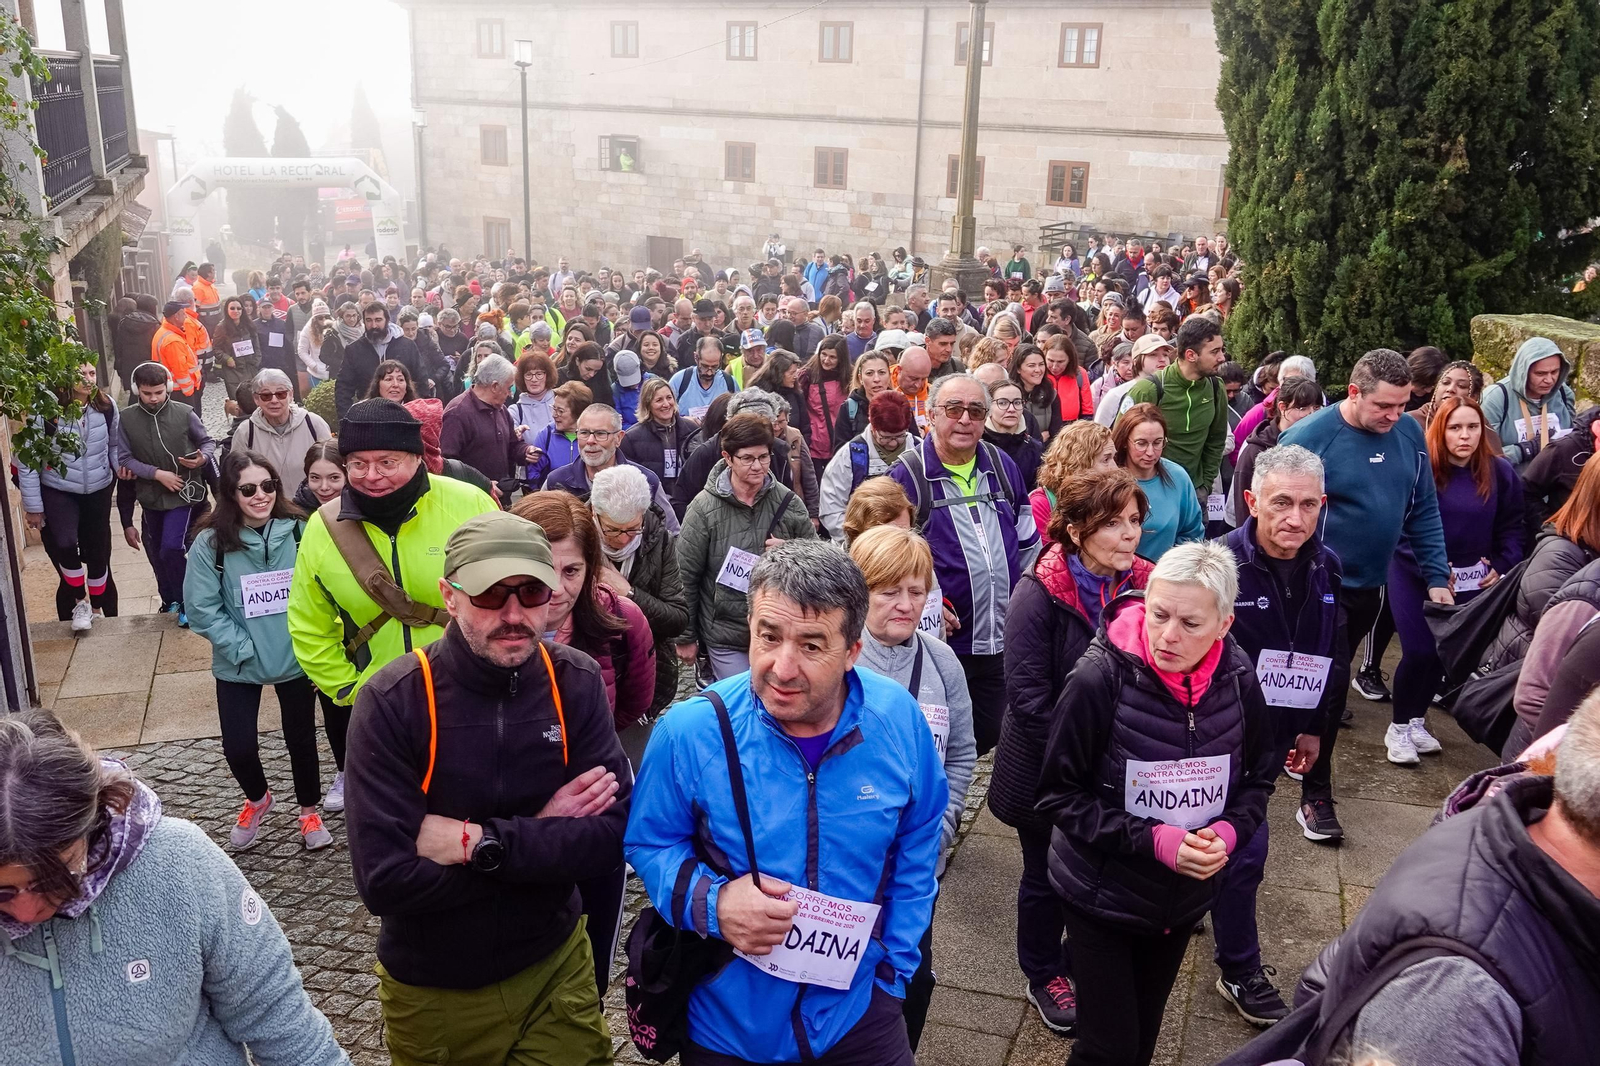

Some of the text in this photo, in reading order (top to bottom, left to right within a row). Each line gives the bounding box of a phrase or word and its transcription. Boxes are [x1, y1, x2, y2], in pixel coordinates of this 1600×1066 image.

[213, 165, 255, 176] HOTEL
[261, 165, 277, 176] LA
[917, 613, 941, 632] AINA
[1295, 660, 1325, 670] CANCRO
[1259, 671, 1323, 693] ANDAINA
[1137, 766, 1223, 779] CONTRA O CANCRO
[1154, 760, 1207, 771] CORREMOS
[1134, 783, 1224, 811] ANDAINA
[787, 889, 853, 913] CORREMOS
[811, 905, 821, 913] O
[822, 908, 866, 924] CANCRO
[784, 923, 861, 962] DAINA
